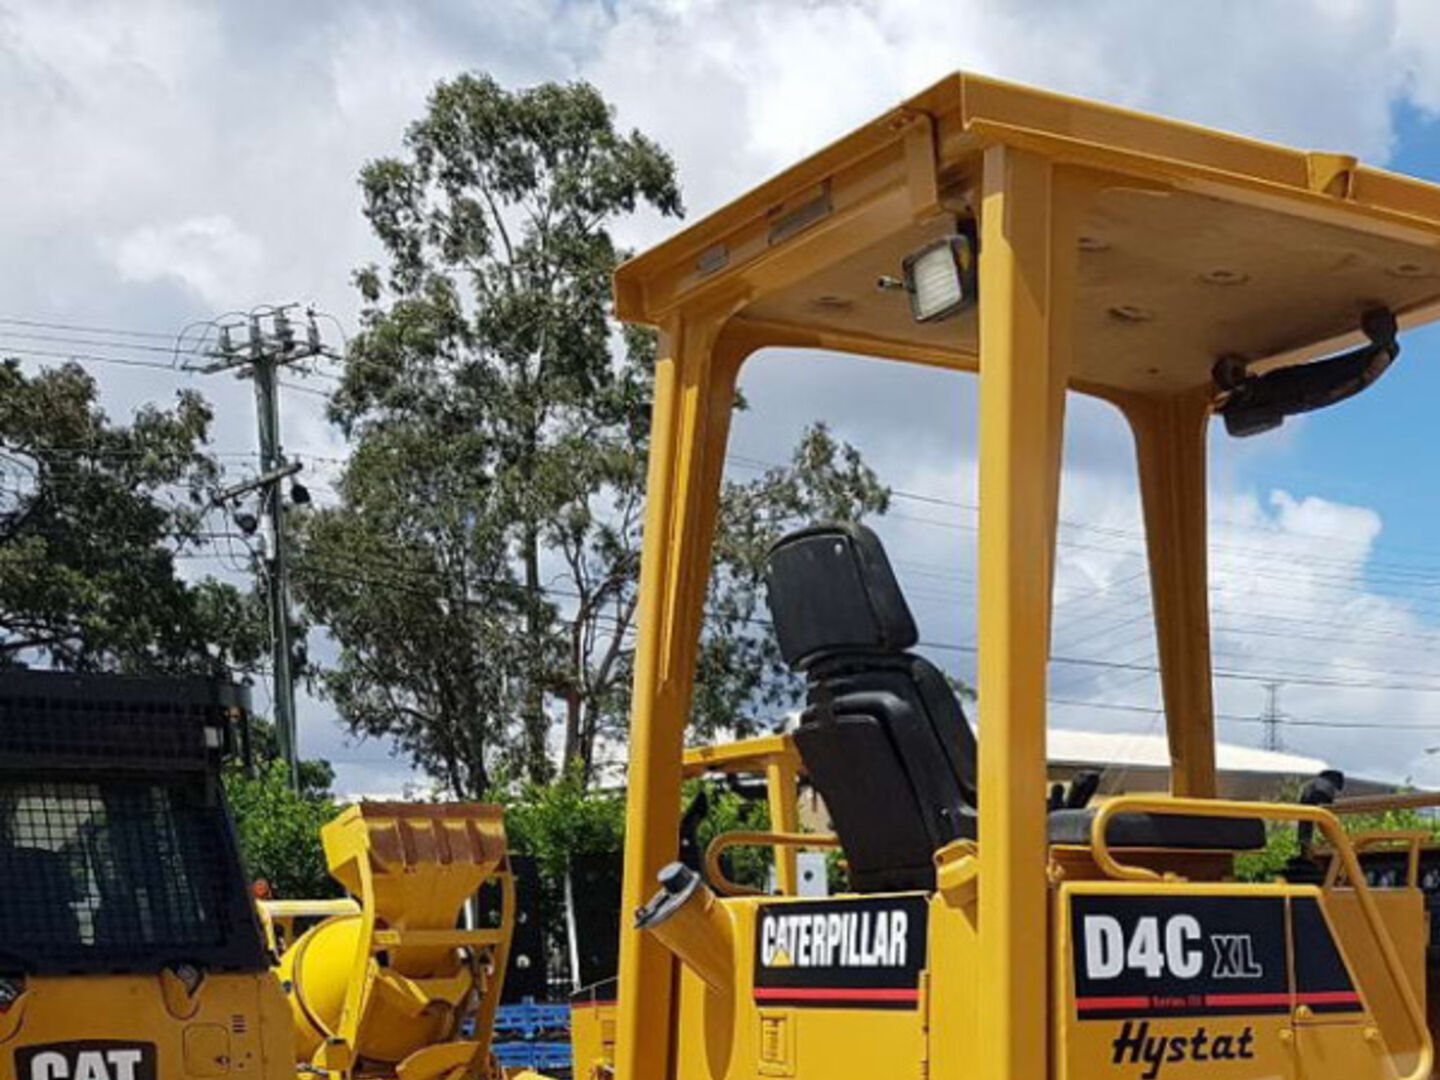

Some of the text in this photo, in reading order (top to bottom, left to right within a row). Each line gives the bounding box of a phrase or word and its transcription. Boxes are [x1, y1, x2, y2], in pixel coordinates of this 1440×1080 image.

[762, 910, 908, 967] CATERPILLAR
[1085, 914, 1263, 980] D4C XL
[1112, 1021, 1255, 1080] Hystat
